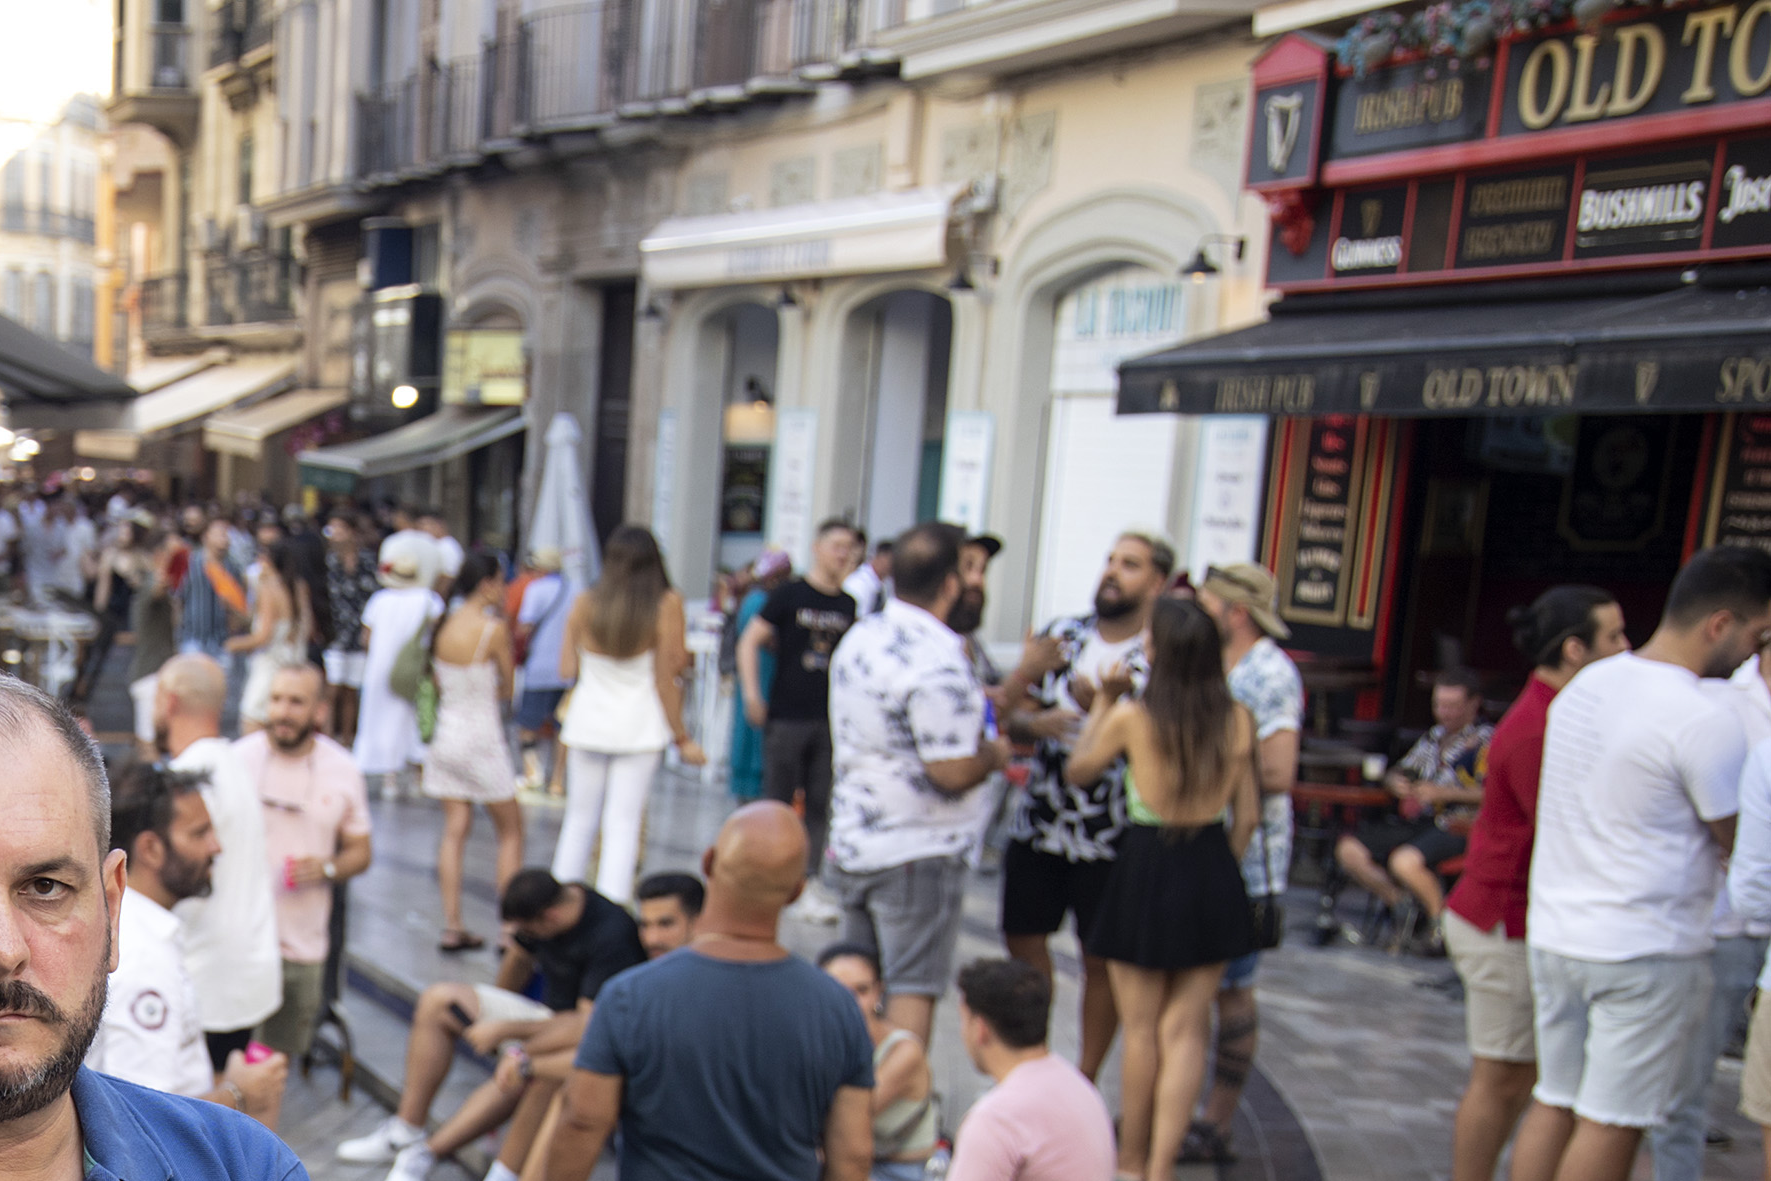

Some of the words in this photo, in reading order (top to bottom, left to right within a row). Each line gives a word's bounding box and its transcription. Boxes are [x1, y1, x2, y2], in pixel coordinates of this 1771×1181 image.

[1518, 22, 1667, 129] OLD
[1577, 181, 1705, 231] BUSHMILLS
[1422, 368, 1483, 409] OLD
[1485, 363, 1578, 408] TOWN
